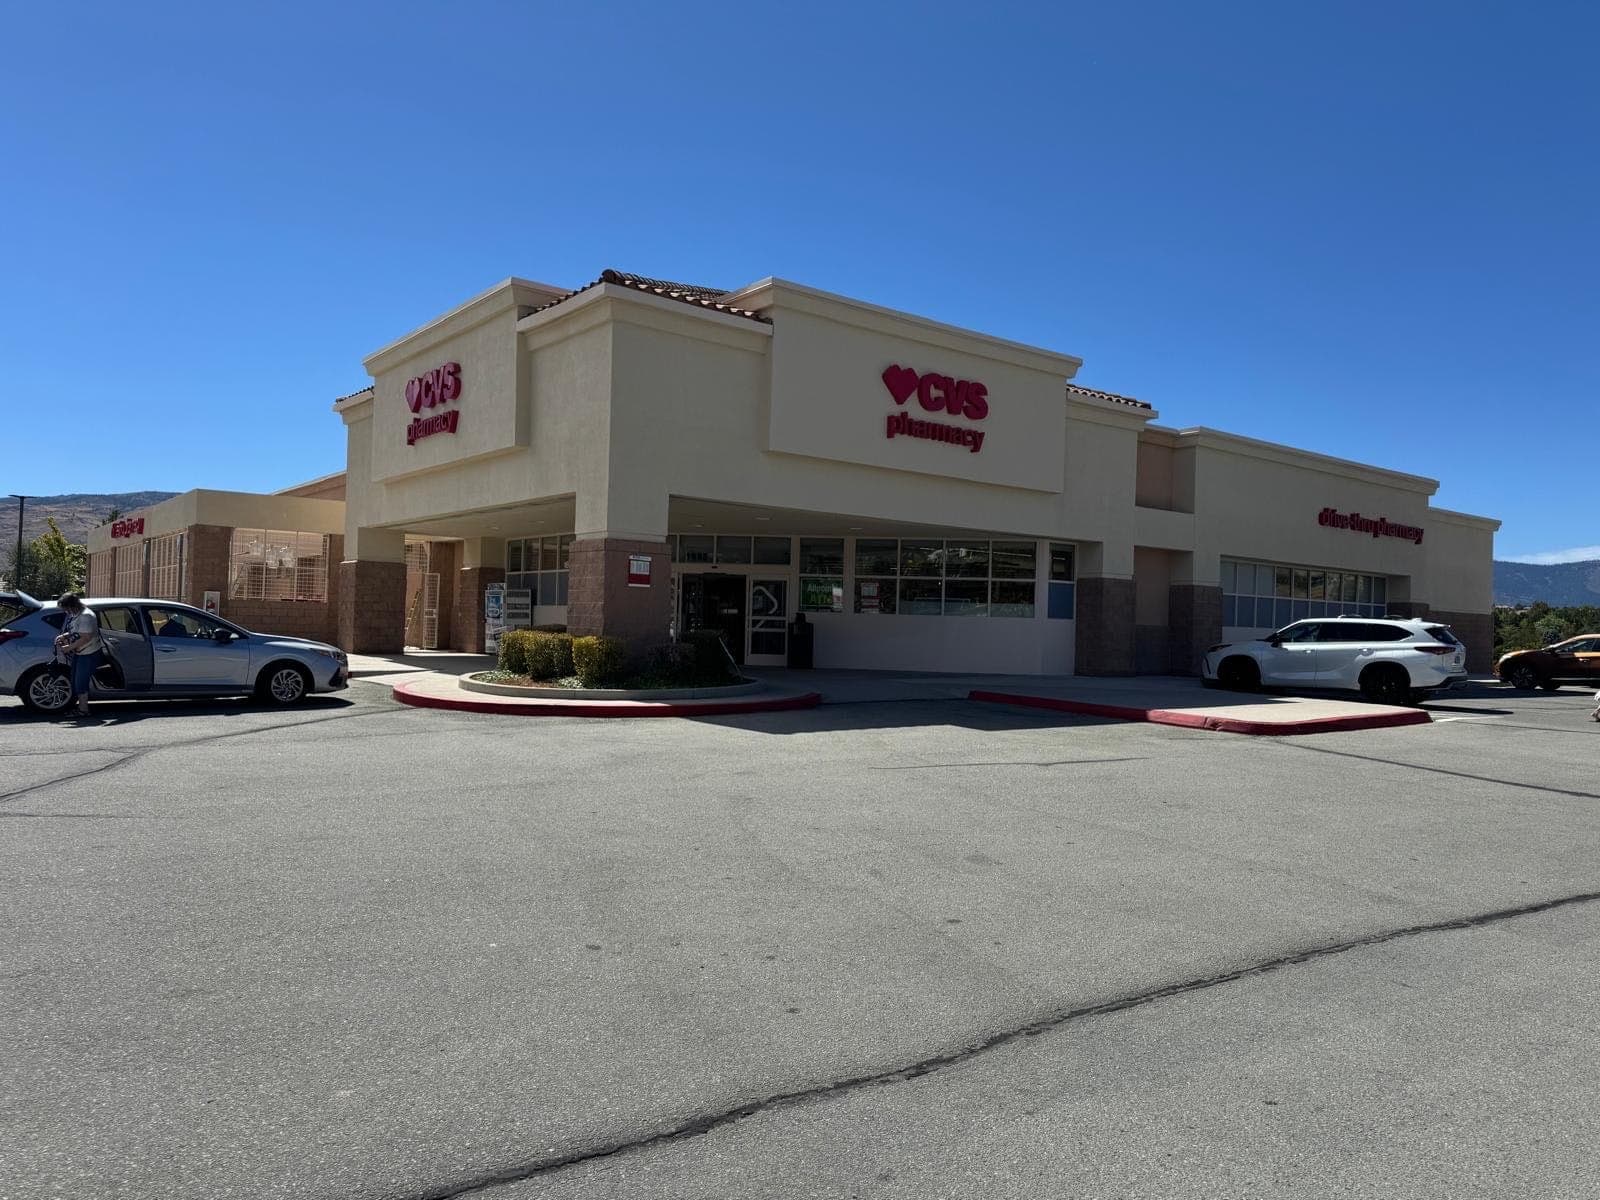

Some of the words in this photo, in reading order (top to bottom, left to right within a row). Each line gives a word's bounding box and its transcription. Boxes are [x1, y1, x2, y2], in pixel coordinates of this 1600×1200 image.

[421, 362, 462, 408] CVS
[917, 373, 989, 420] CVS
[406, 410, 459, 446] pharmacy
[886, 411, 985, 453] pharmacy
